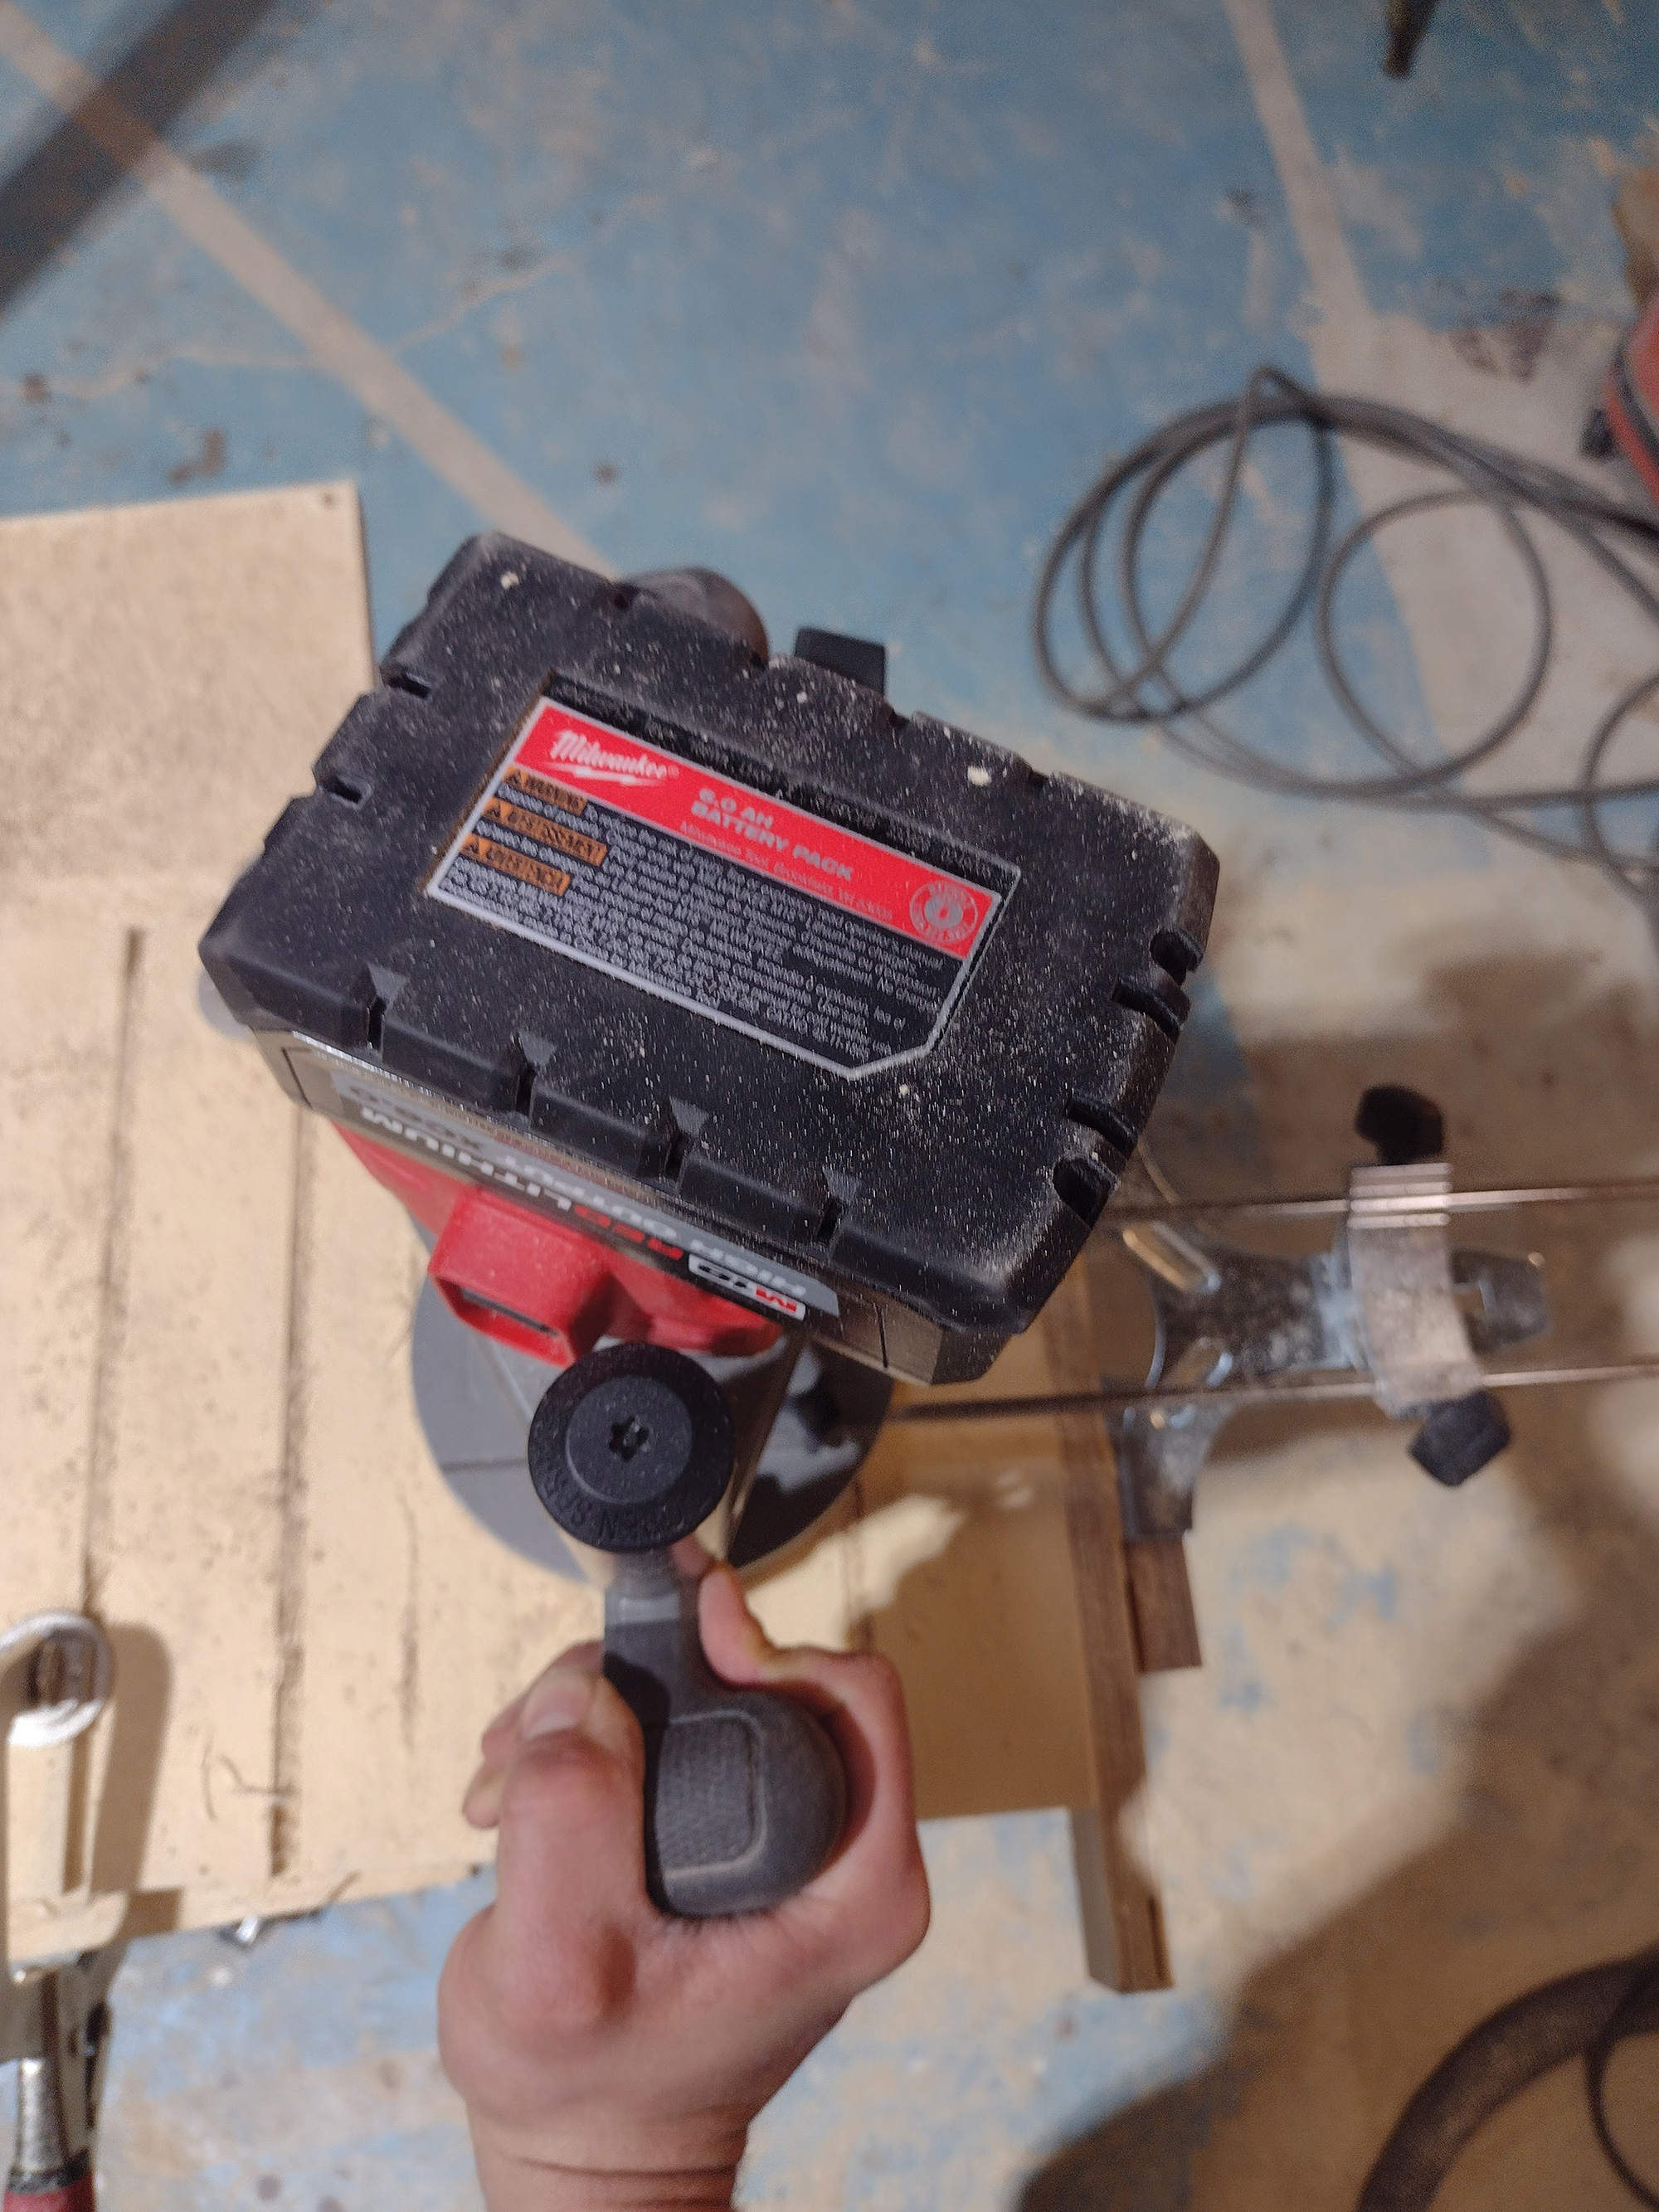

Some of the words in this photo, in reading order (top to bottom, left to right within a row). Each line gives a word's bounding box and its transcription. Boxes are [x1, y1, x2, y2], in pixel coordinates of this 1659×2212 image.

[547, 727, 668, 780] Milwaukee
[688, 799, 789, 853] BATTERY
[790, 843, 856, 882] PACK
